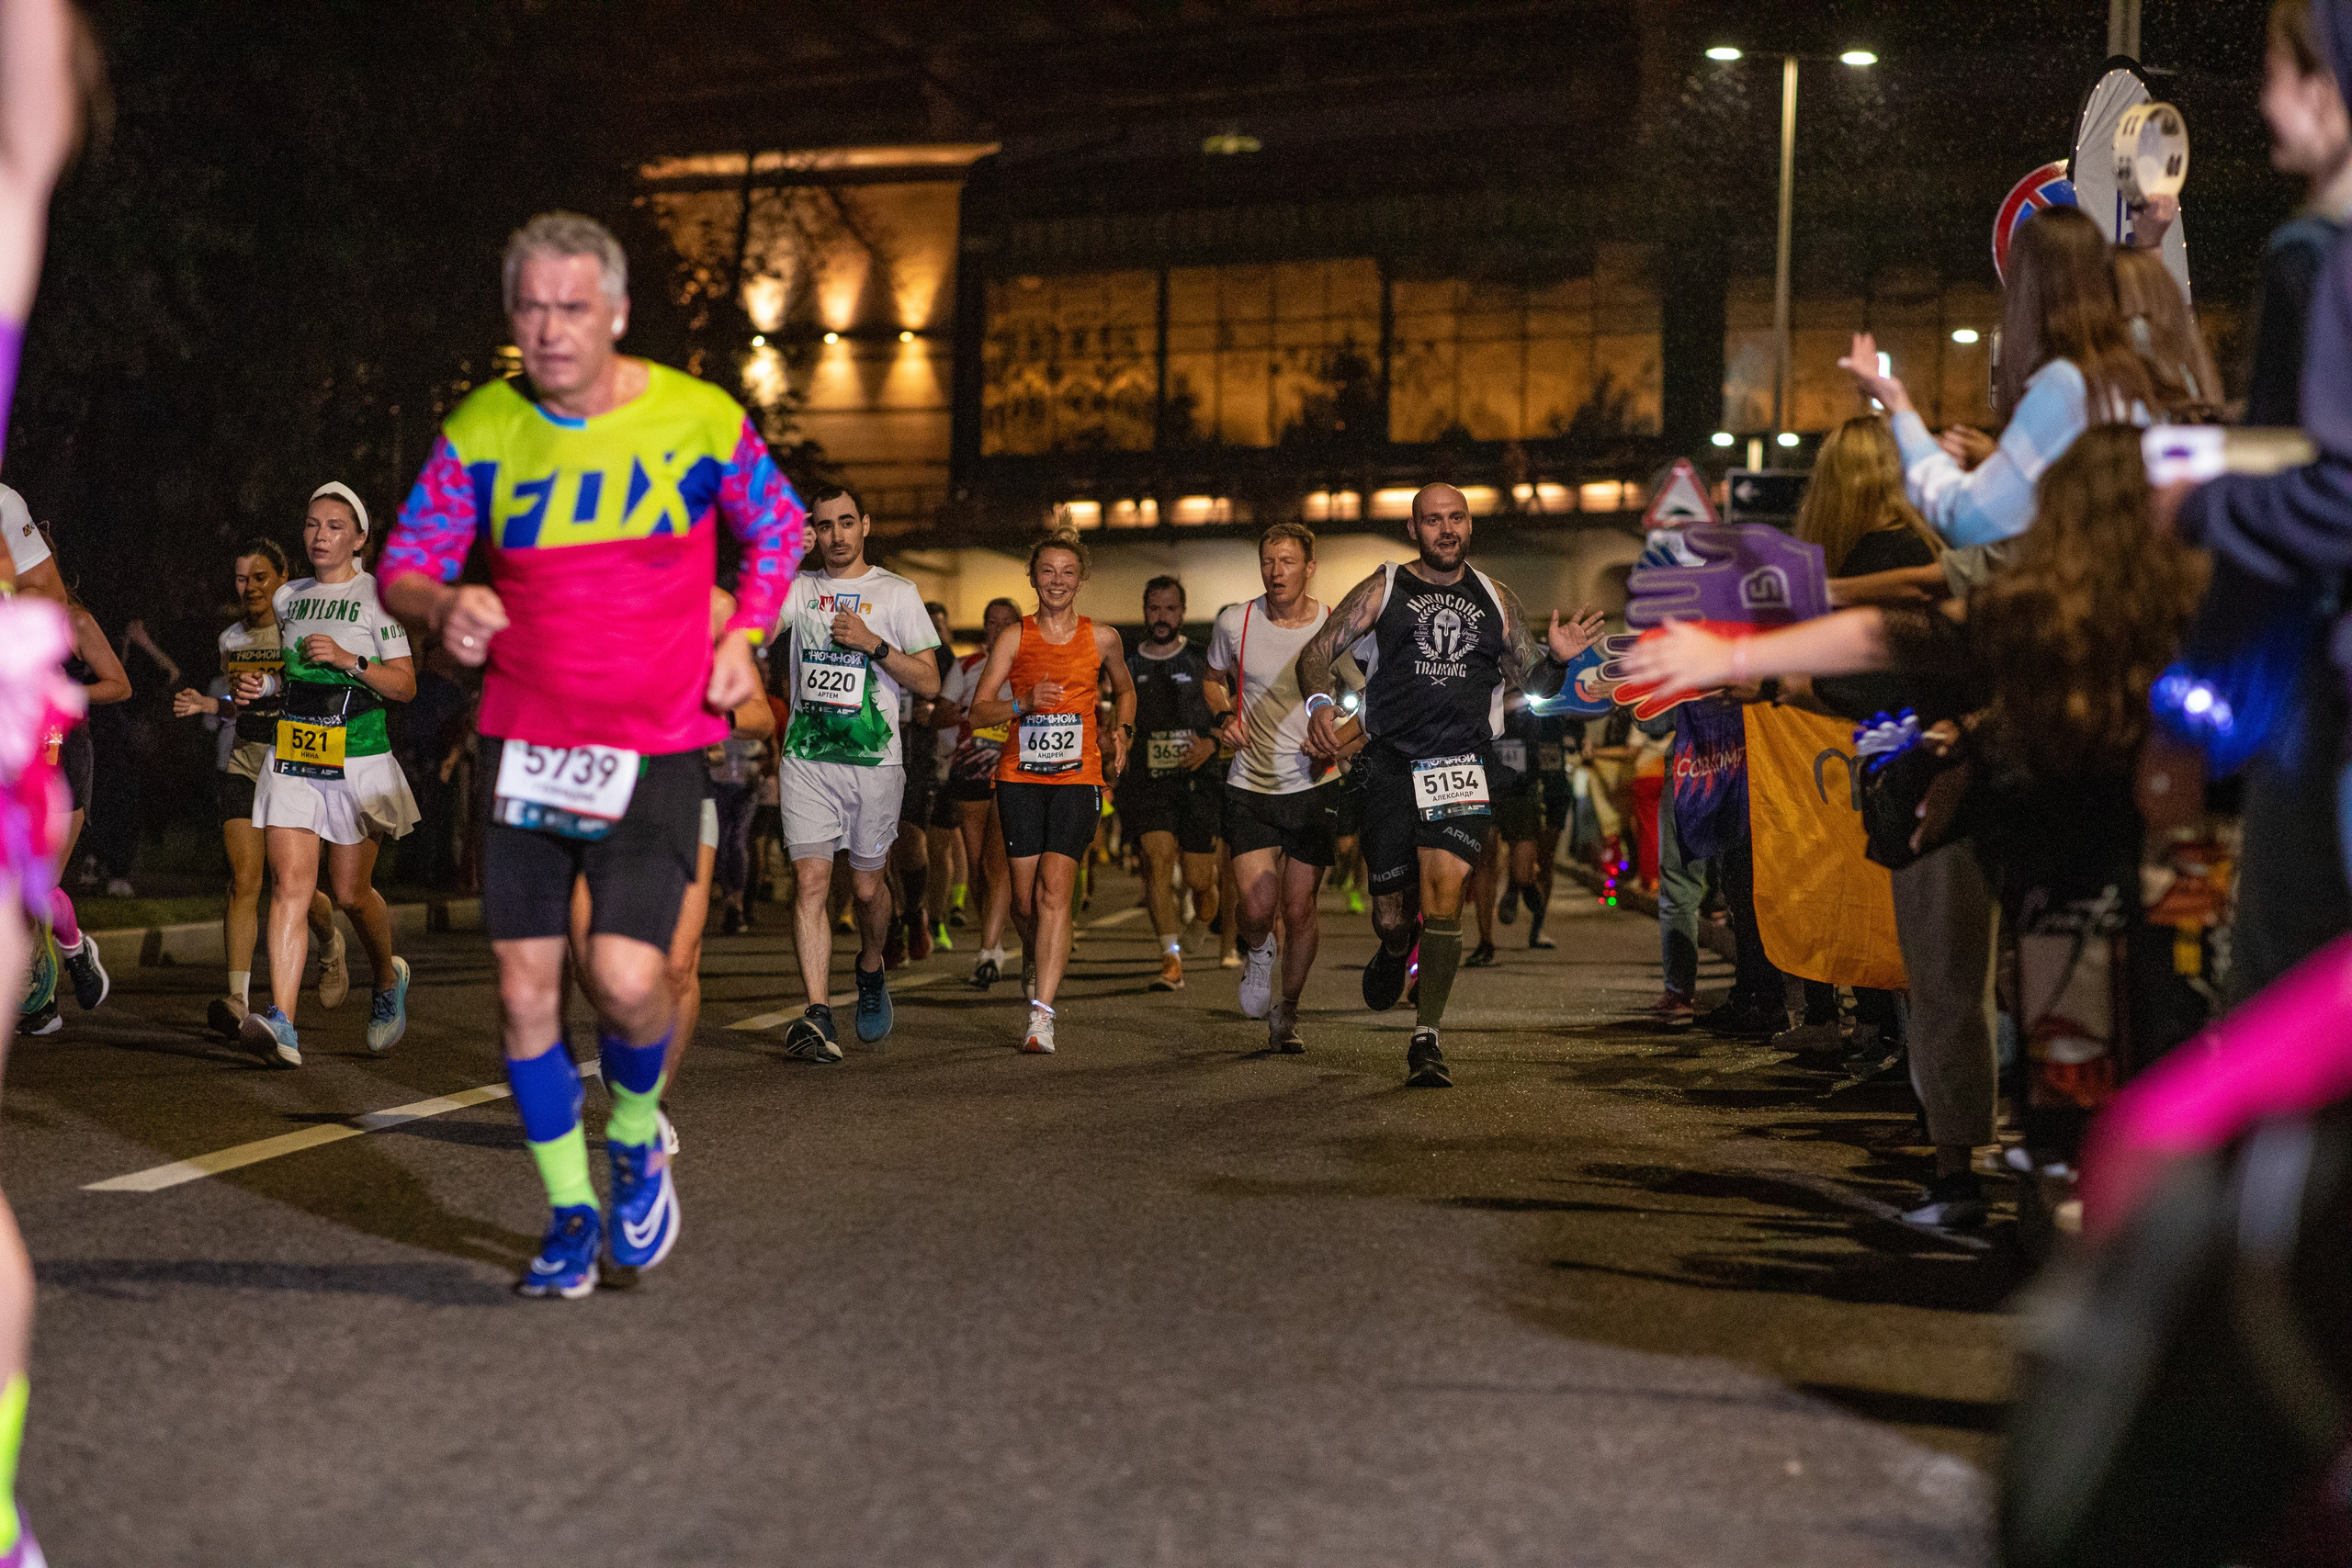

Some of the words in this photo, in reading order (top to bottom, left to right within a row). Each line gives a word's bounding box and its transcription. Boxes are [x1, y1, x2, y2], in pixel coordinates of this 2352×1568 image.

[491, 451, 695, 549] FOX
[1407, 592, 1486, 622] HARDCORE
[808, 649, 862, 665] НОЧНОЙ
[1415, 660, 1467, 678] TRAINING
[807, 669, 856, 693] 6220
[1025, 713, 1077, 724] НОЧНОЙ
[292, 728, 328, 751] 521
[1028, 730, 1075, 750] 6632
[300, 751, 320, 760] НИНА
[1037, 751, 1064, 760] АНДРЕЙ
[281, 761, 289, 773] F
[525, 750, 617, 789] 5739
[1423, 770, 1479, 795] 5154
[1432, 791, 1474, 802] АЛЕКСАНДР
[1425, 808, 1433, 821] F
